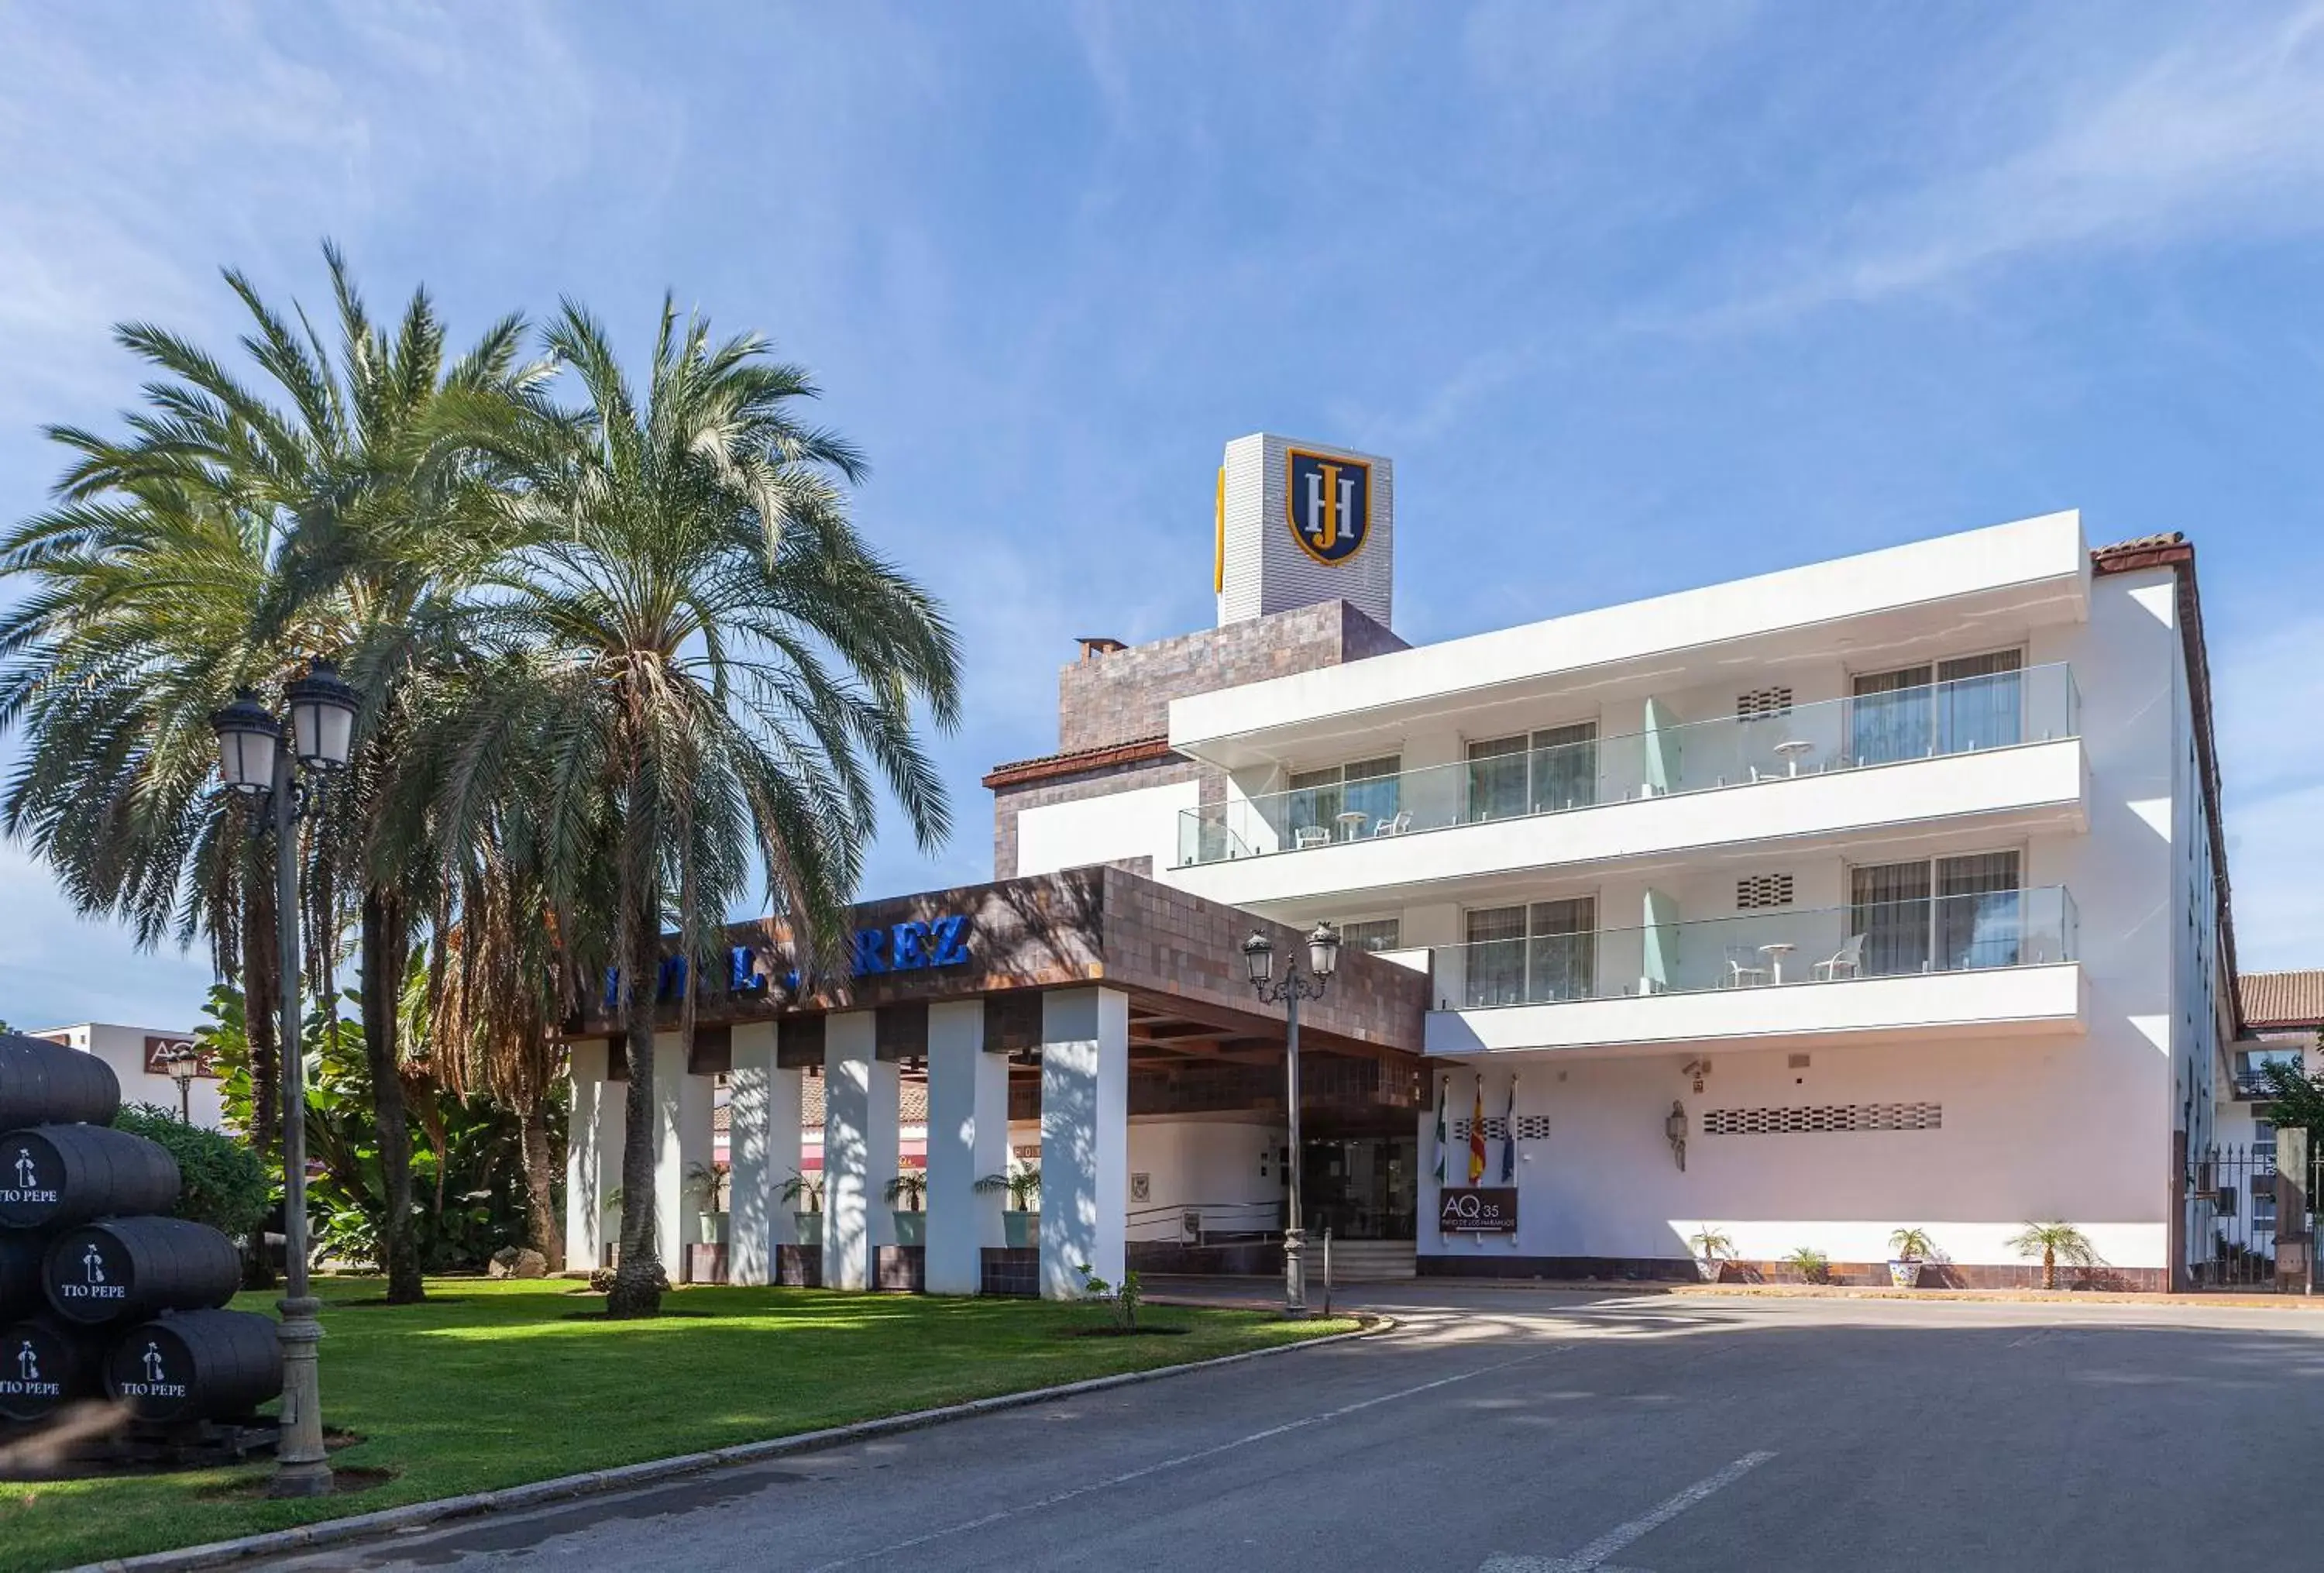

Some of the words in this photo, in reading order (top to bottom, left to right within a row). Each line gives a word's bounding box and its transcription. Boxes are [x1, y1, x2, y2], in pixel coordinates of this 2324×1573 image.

[23, 1190, 57, 1202] PEPE
[1442, 1195, 1480, 1219] AQ
[1483, 1205, 1499, 1217] 35
[61, 1284, 88, 1296] TIO
[91, 1286, 125, 1298] PEPE
[26, 1382, 60, 1395] PEPE
[122, 1382, 148, 1395] TIO
[151, 1384, 185, 1397] PEPE
